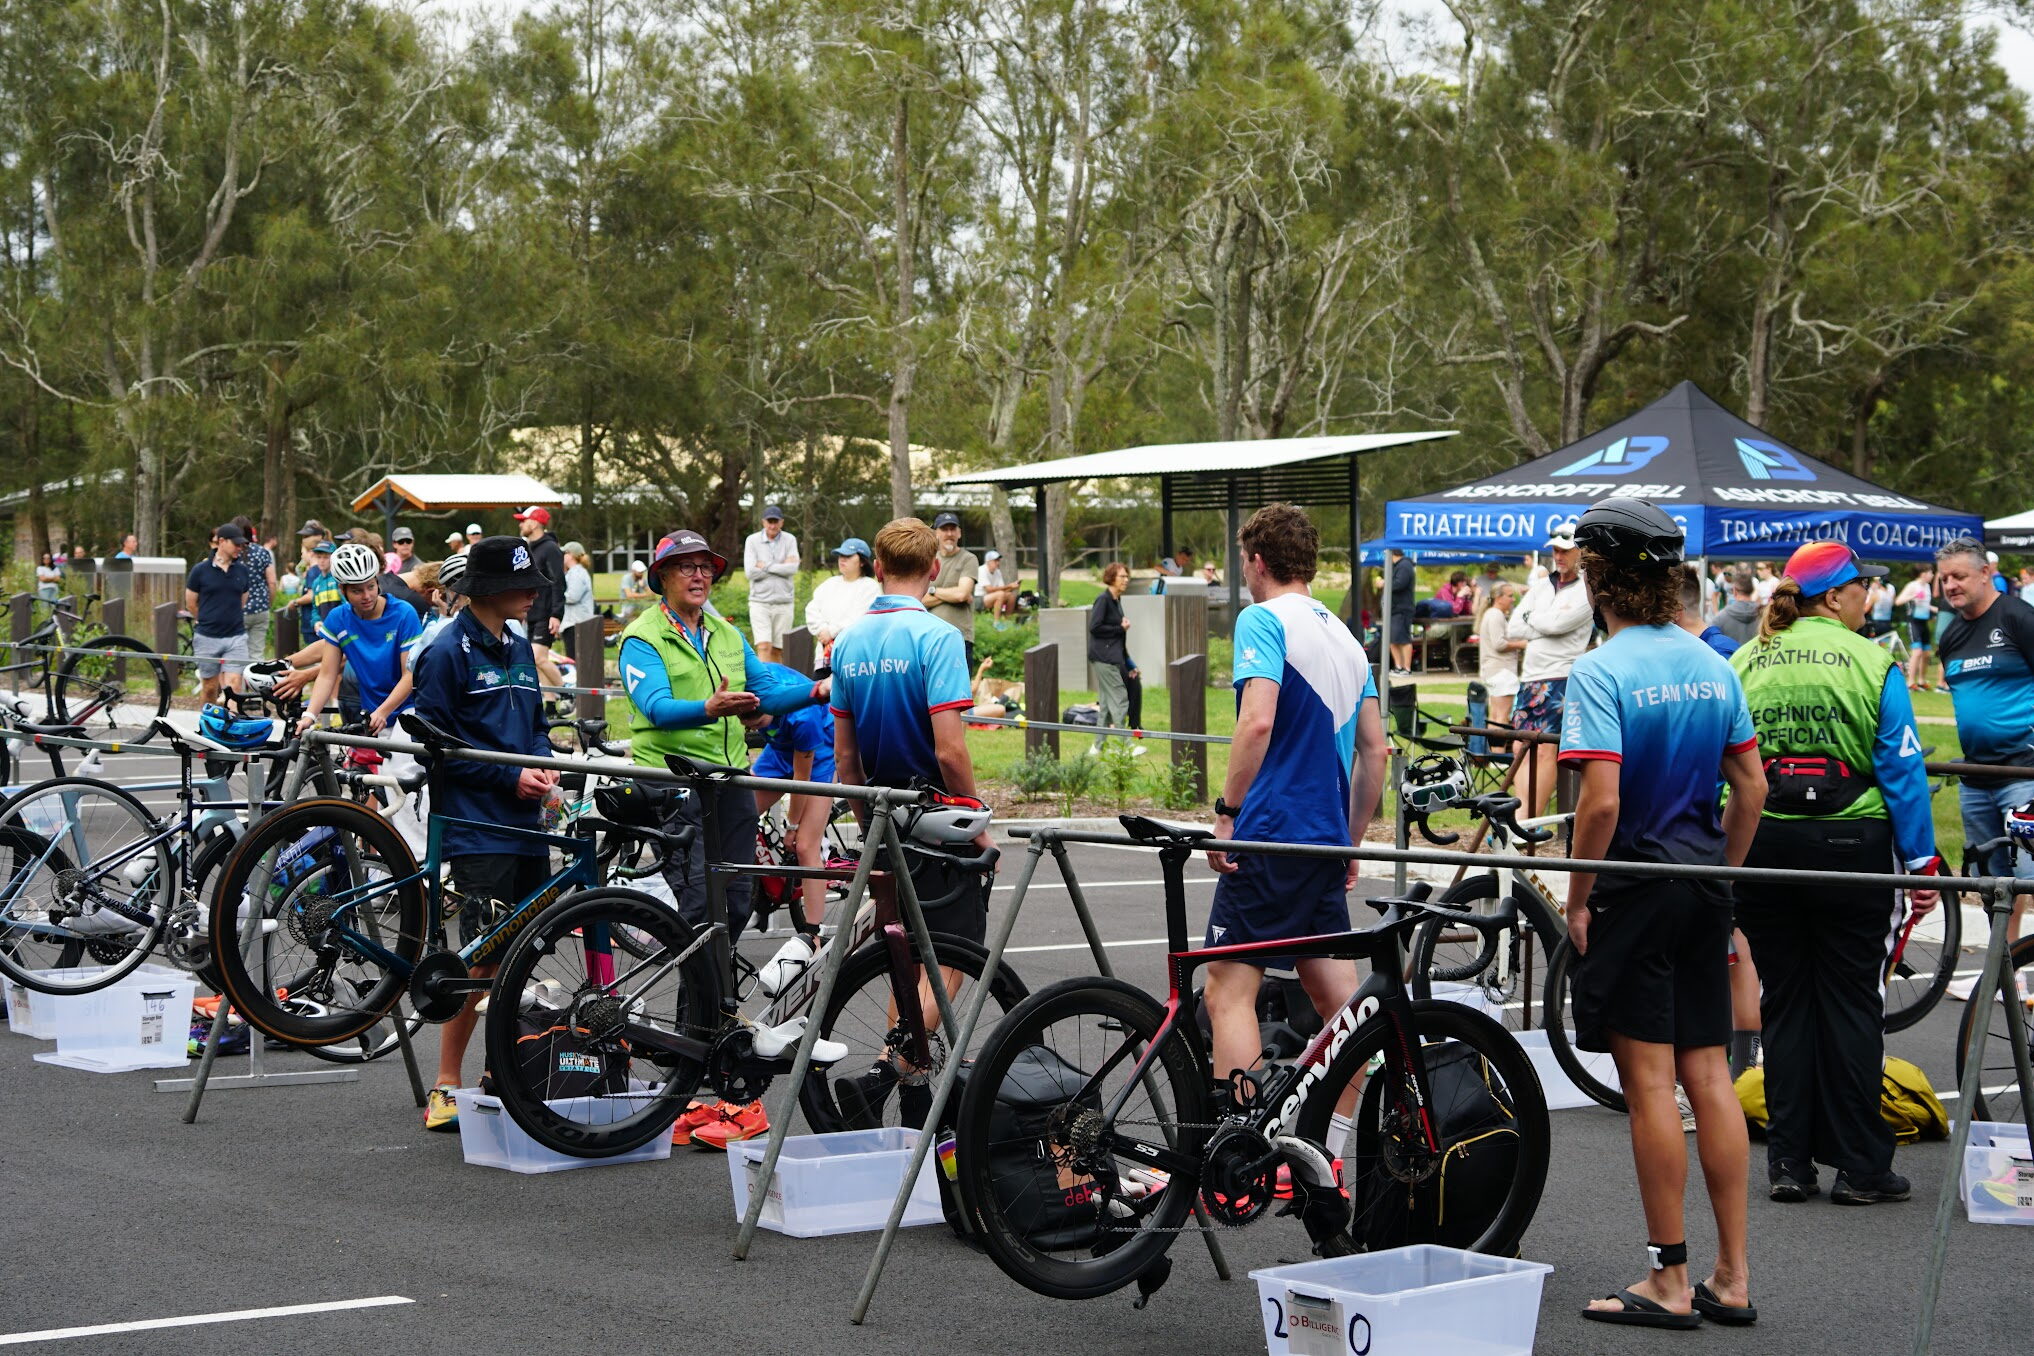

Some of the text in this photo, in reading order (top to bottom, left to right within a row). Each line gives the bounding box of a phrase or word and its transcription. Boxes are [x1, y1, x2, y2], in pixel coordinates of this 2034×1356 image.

[1443, 483, 1687, 499] ASHCROFT BELL
[1712, 486, 1929, 510] ASHCROFT BELL
[1399, 513, 1536, 537] TRIATHLON
[1720, 519, 1850, 543] TRIATHLON
[1748, 649, 1852, 673] TRIATHLON
[1963, 655, 1993, 669] BKN
[1631, 681, 1727, 709] TEAM NSW
[1566, 701, 1583, 745] NSW
[471, 886, 560, 963] cannondale
[559, 1057, 600, 1069] ULTIMATE
[1267, 1297, 1289, 1339] 2
